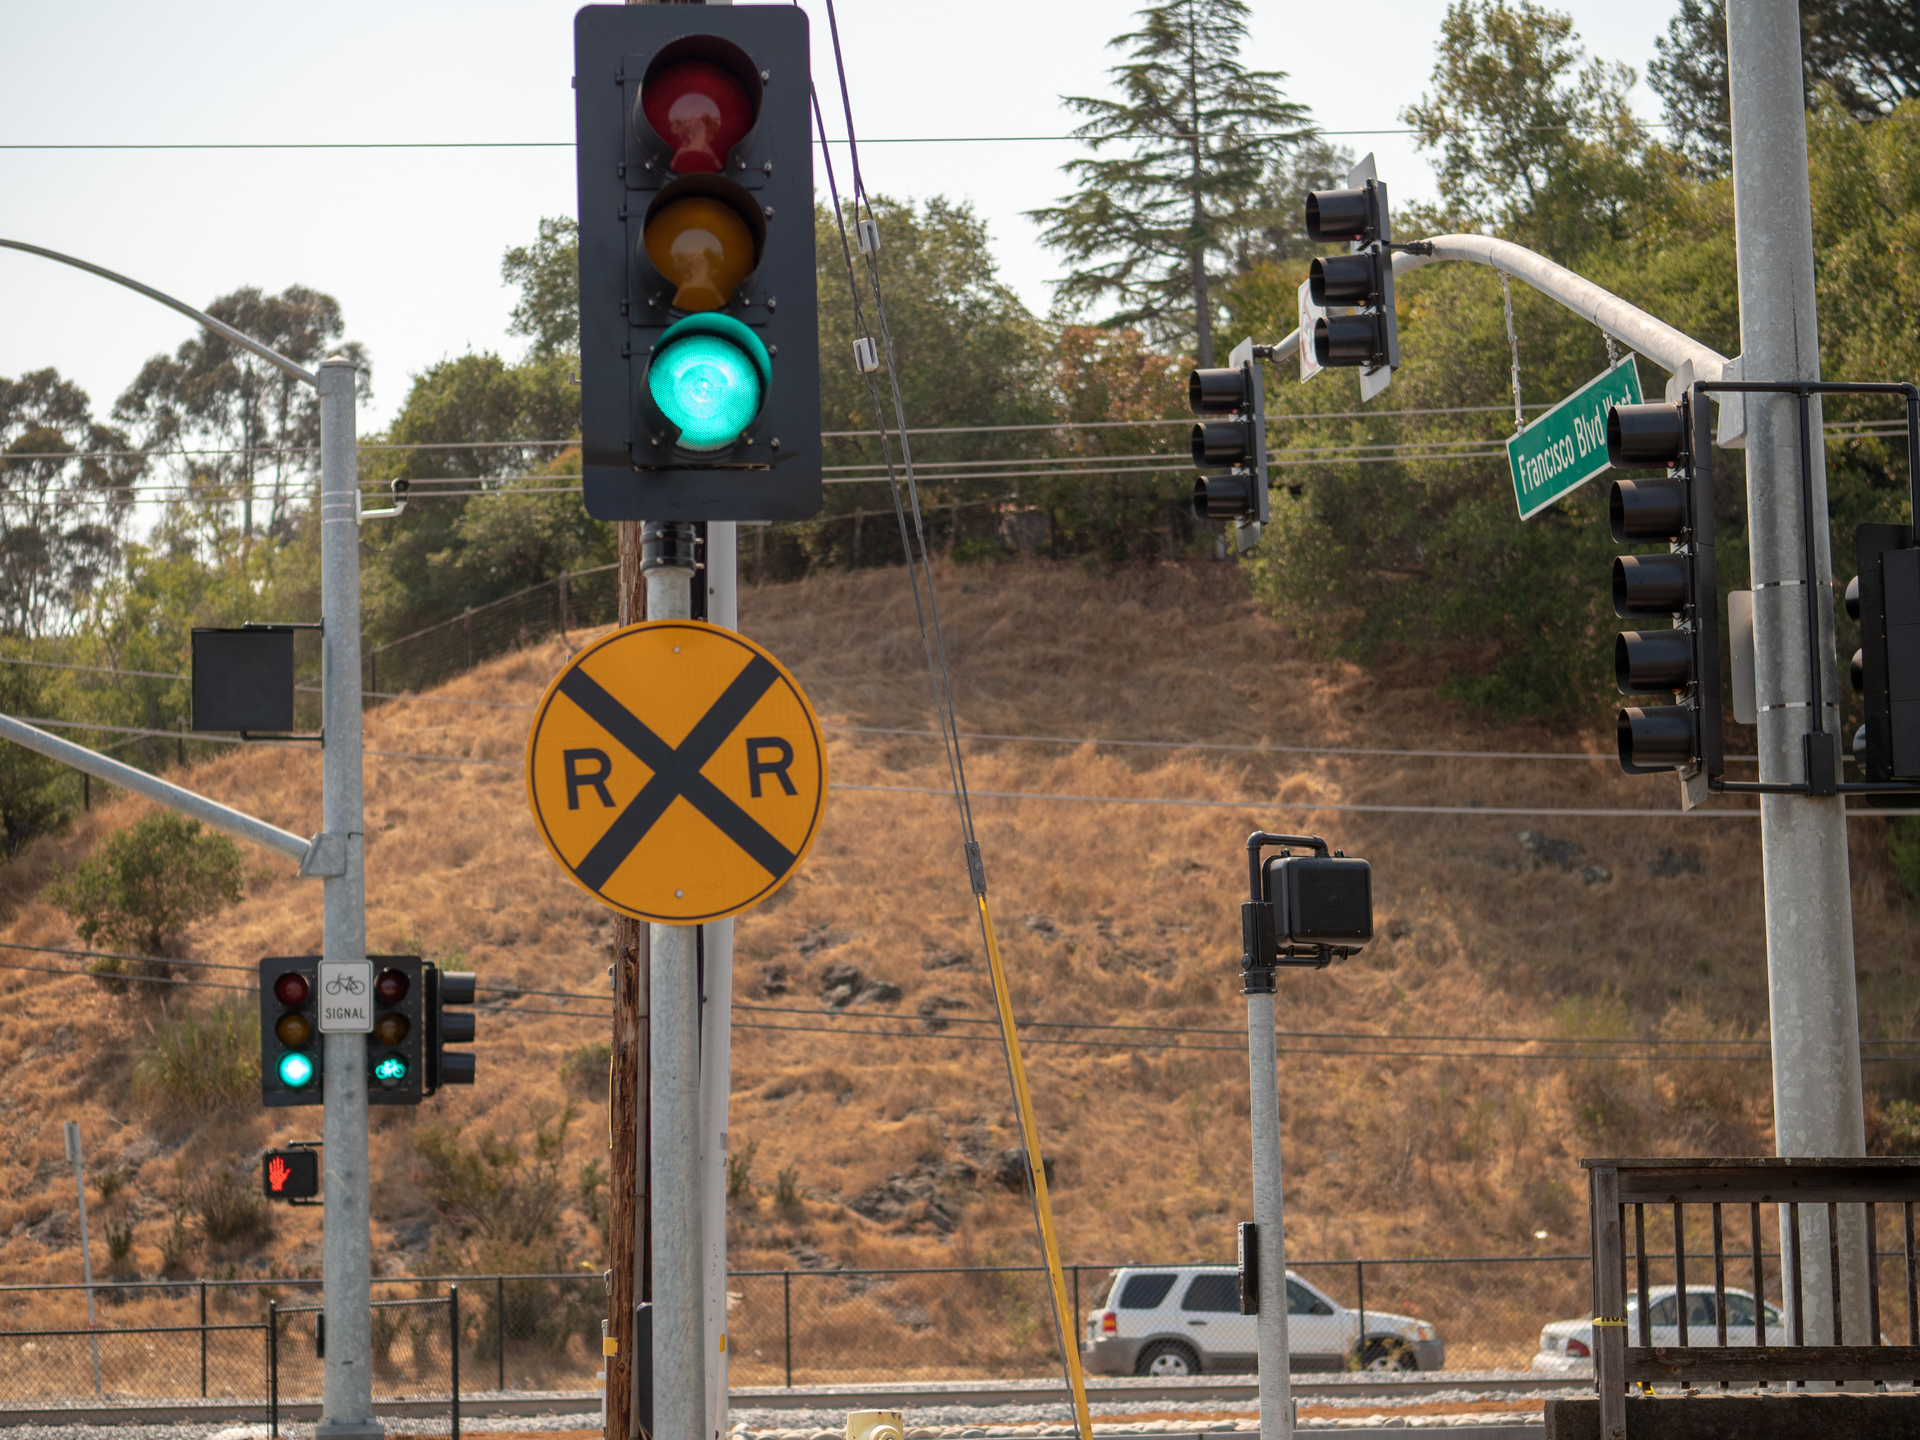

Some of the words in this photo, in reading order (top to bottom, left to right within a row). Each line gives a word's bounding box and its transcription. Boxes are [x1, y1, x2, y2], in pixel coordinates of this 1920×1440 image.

[1518, 435, 1575, 494] Francisco
[1573, 404, 1606, 458] Blvd
[563, 747, 617, 810] R
[746, 736, 799, 798] R
[325, 1007, 366, 1020] SIGNAL
